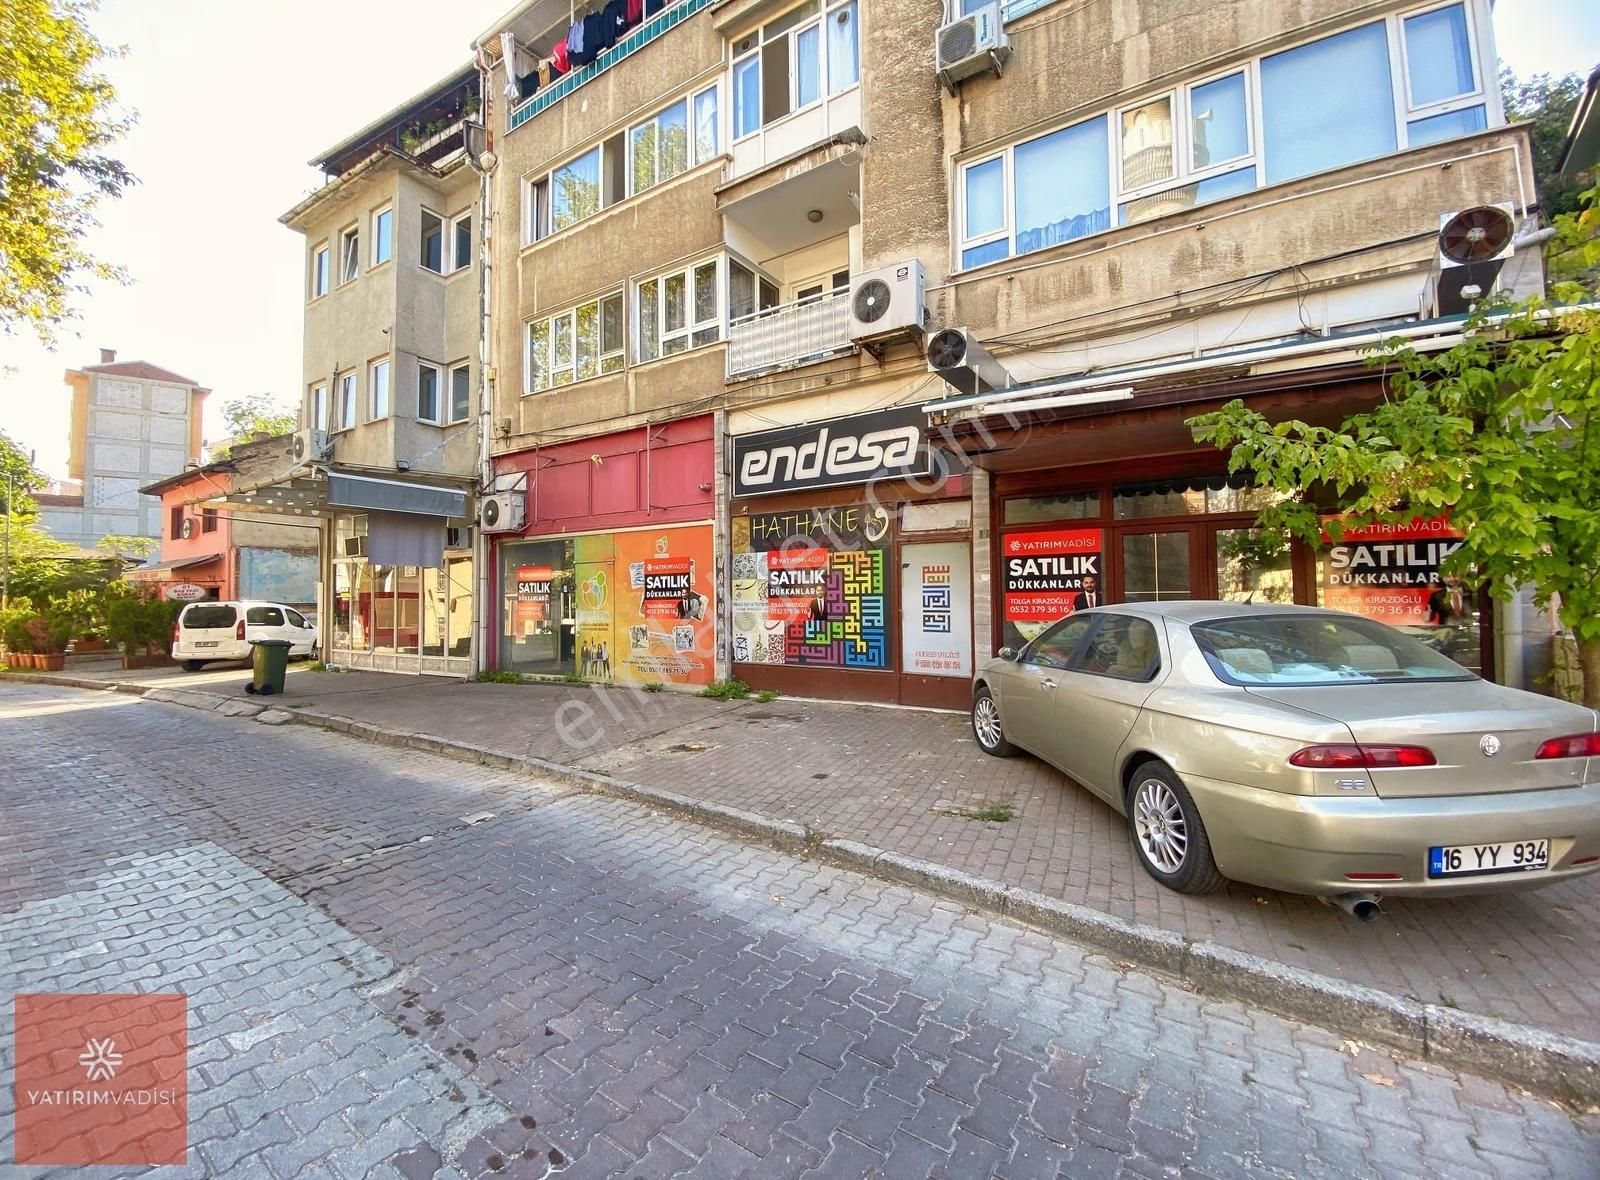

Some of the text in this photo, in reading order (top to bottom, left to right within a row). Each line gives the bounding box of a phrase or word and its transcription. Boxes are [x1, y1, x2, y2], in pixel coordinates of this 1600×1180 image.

[740, 425, 920, 486] endesa
[752, 509, 860, 540] HATHANE
[1022, 537, 1096, 549] YATIRIMVADİSİ
[1009, 556, 1098, 576] SATILIK
[646, 575, 689, 588] SATILIK
[770, 570, 825, 585] SATILIK
[1330, 571, 1440, 584] DÜKKANLAR
[518, 582, 551, 593] SATILIK
[1009, 579, 1081, 589] DÜKKANLAR
[646, 590, 682, 598] DÜKKANLAR
[770, 587, 815, 595] DÜKKANLAR
[1010, 605, 1069, 613] 0532 379 36 16
[1363, 606, 1385, 614] 379
[1388, 606, 1403, 614] 36
[1407, 606, 1421, 614] 16
[1444, 841, 1547, 870] 16 YY 934
